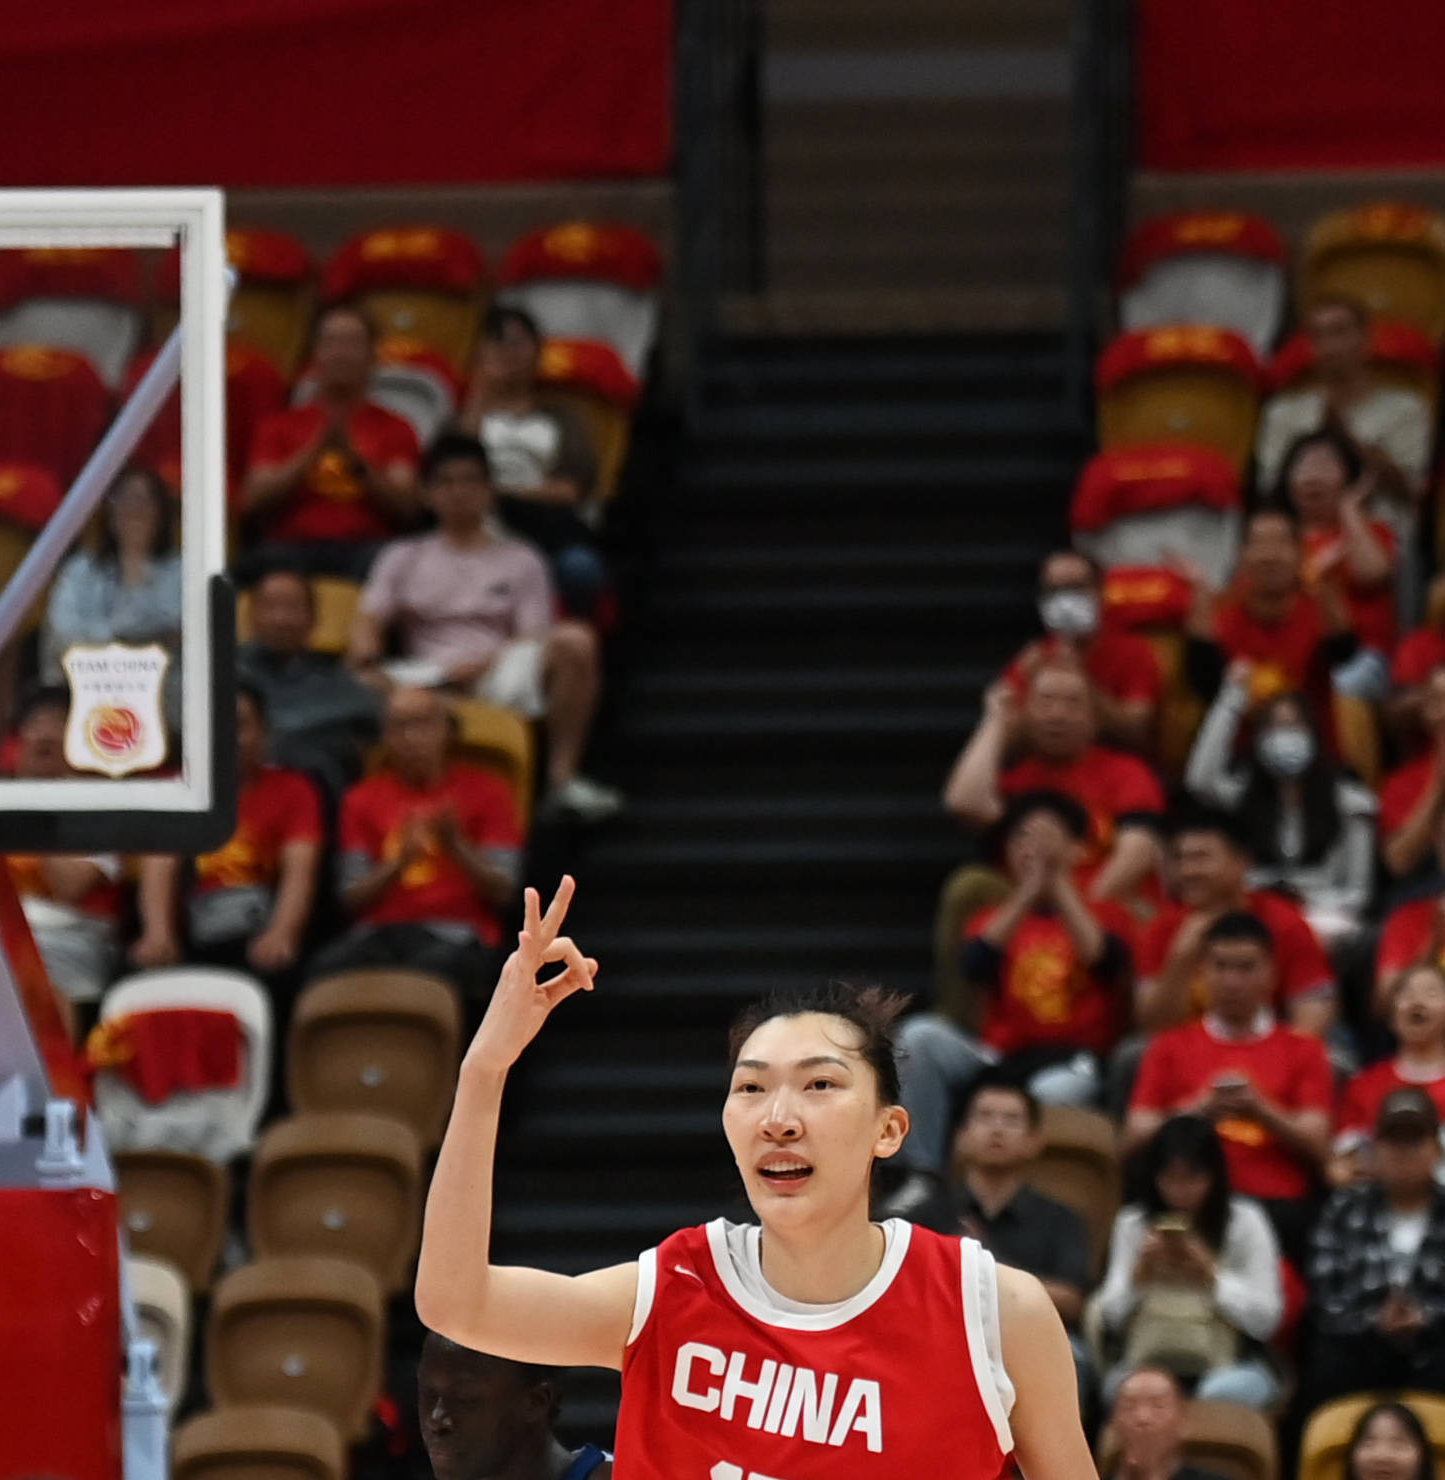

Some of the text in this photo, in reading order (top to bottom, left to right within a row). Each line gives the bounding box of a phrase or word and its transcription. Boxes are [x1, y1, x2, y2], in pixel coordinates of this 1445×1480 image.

[70, 660, 158, 673] TEAM CHINA
[671, 1341, 883, 1453] CHINA
